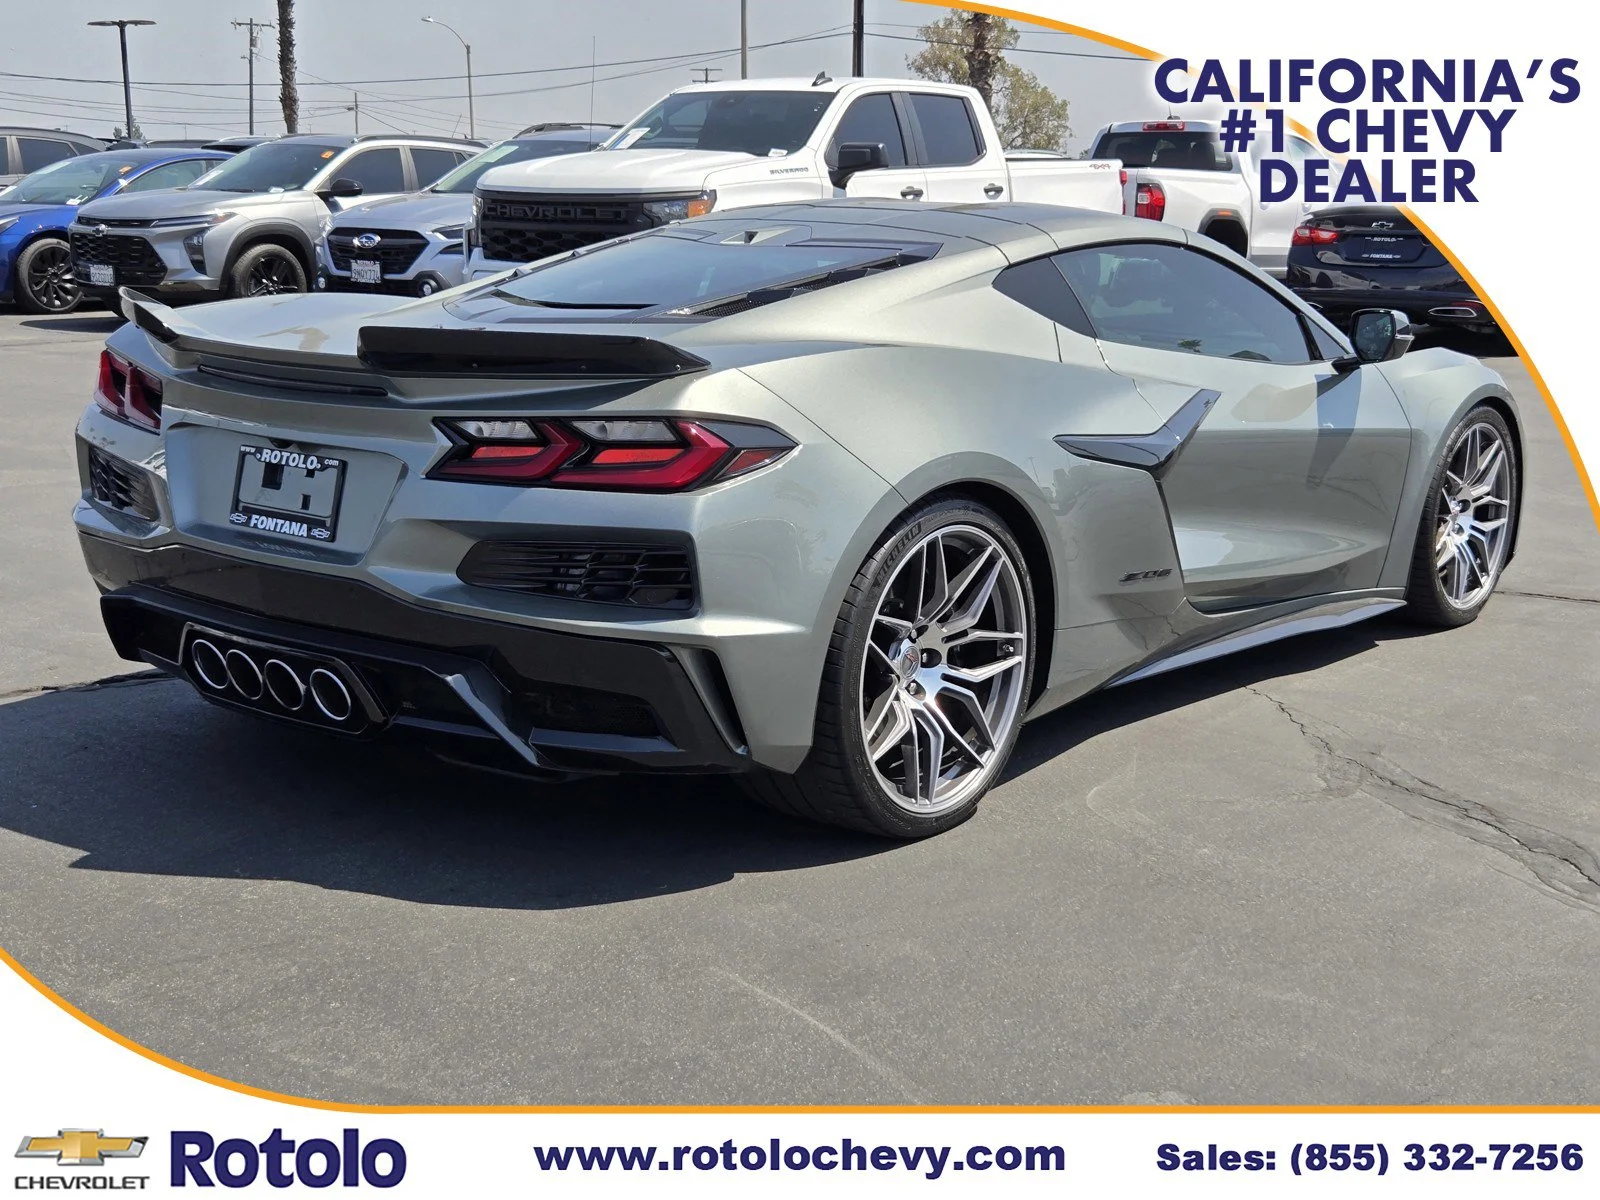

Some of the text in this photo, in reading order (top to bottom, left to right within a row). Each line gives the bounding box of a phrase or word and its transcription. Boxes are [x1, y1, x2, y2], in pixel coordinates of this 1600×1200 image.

[484, 204, 632, 221] CHEVROLET
[250, 514, 308, 538] FONTANA
[875, 522, 921, 586] MICHELIN
